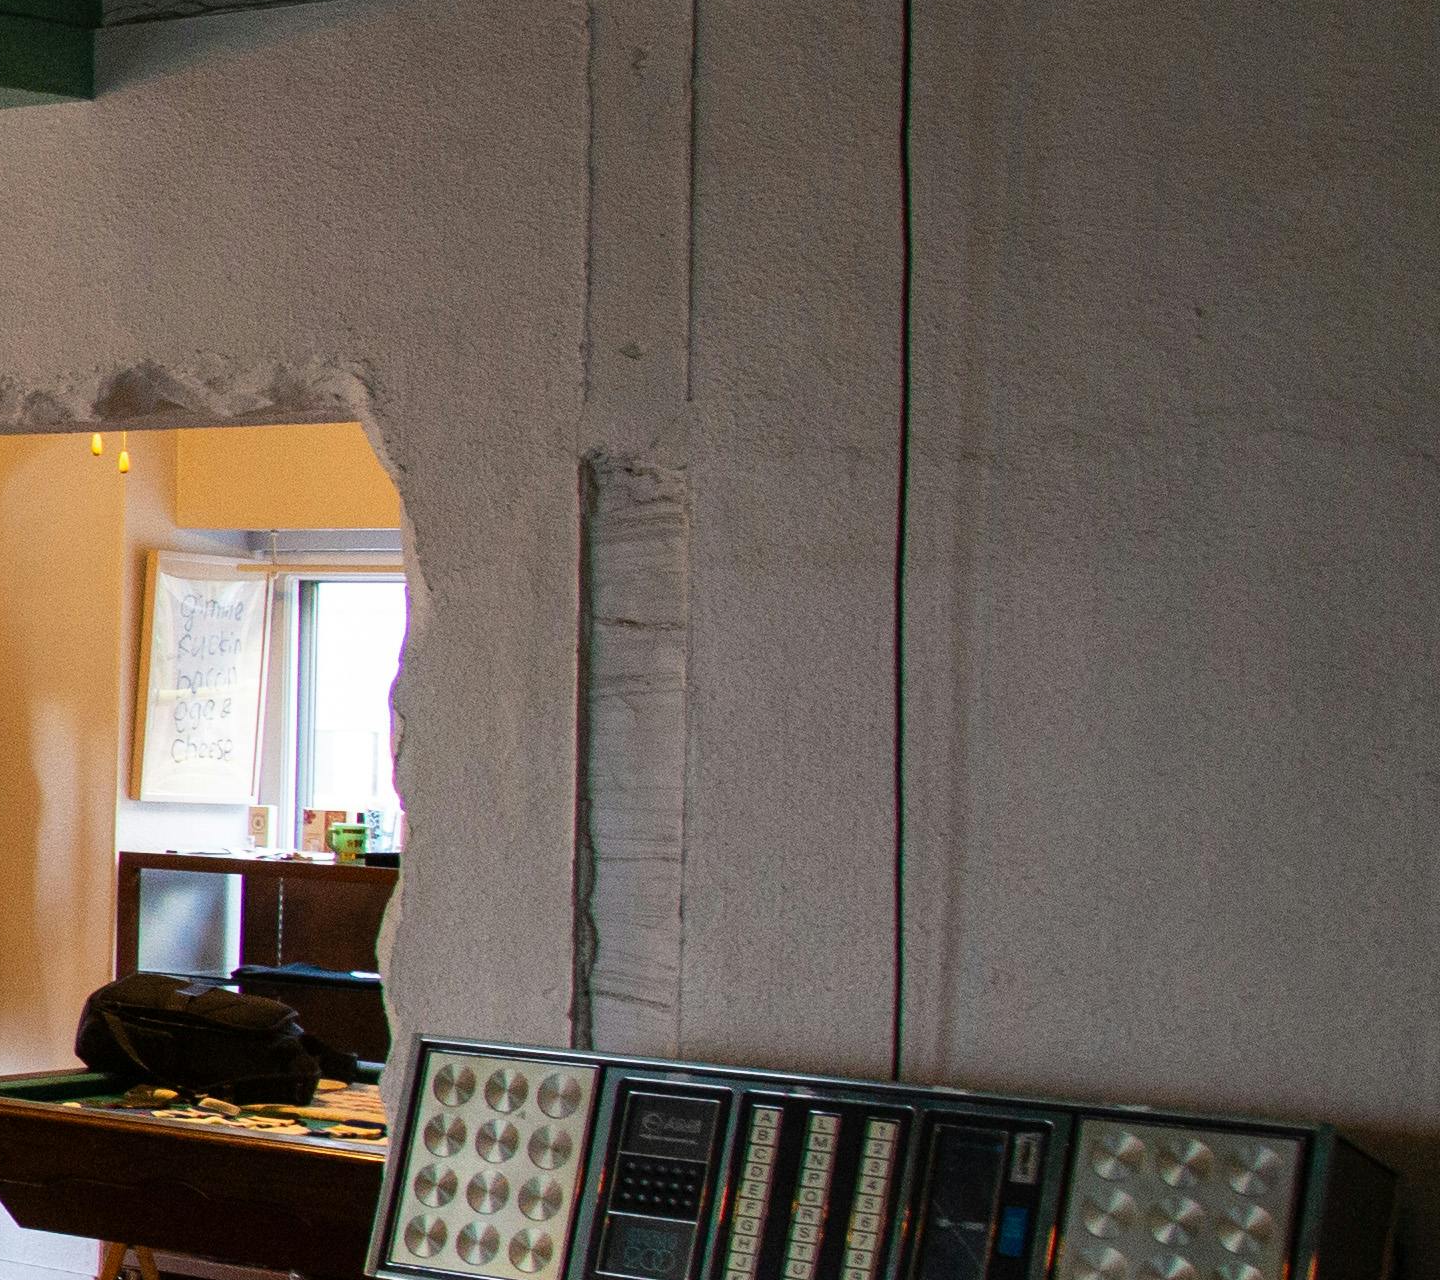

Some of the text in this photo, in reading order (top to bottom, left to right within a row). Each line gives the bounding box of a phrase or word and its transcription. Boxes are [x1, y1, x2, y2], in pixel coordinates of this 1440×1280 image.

[180, 593, 244, 632] gimme
[761, 1113, 772, 1123] A
[818, 1119, 829, 1129] L
[758, 1129, 769, 1141] B
[813, 1136, 828, 1148] M
[754, 1148, 766, 1160] C
[874, 1144, 884, 1155] 2
[810, 1155, 825, 1166] N
[750, 1166, 763, 1177] D
[808, 1173, 820, 1184] P
[749, 1184, 760, 1196] E
[867, 1180, 878, 1191] 4
[864, 1199, 874, 1209] 5
[801, 1209, 815, 1220] R
[741, 1220, 754, 1232] G
[798, 1227, 810, 1239] S
[738, 1239, 750, 1249] H
[859, 1235, 869, 1245] 7
[796, 1245, 808, 1256] T
[792, 1264, 806, 1275] U
